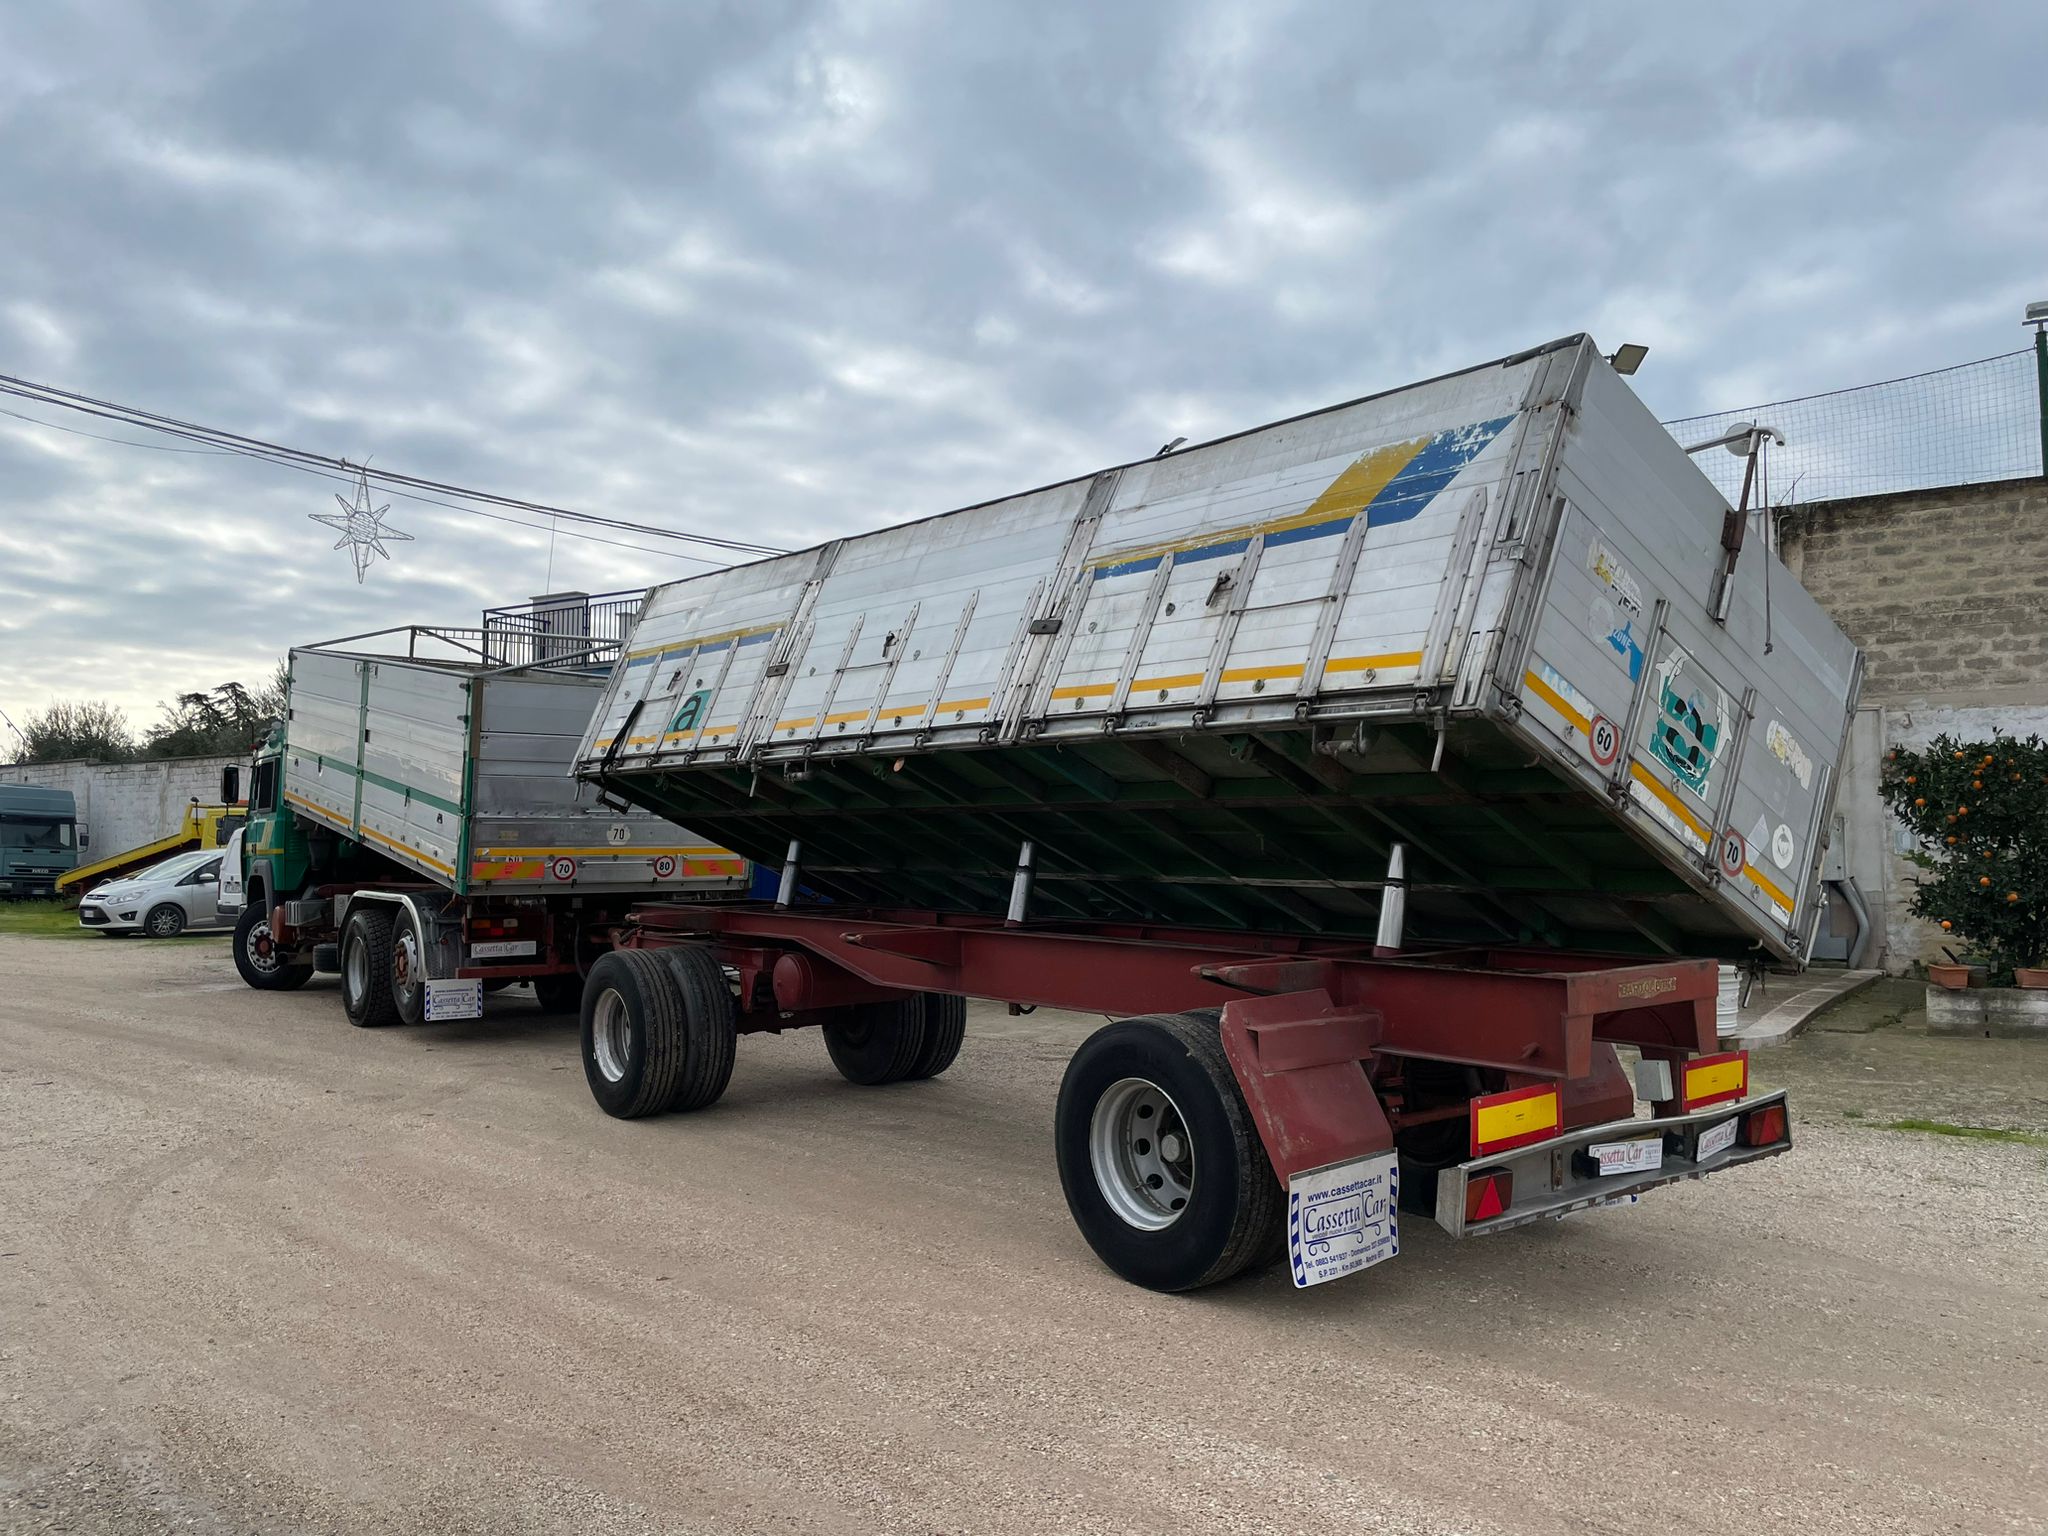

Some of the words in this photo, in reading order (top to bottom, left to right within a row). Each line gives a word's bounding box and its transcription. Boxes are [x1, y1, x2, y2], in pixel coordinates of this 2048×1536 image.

[1597, 727, 1612, 751] 60
[613, 829, 625, 840] 70
[1727, 842, 1739, 864] 70
[559, 864, 570, 874] 70
[659, 862, 670, 871] 80
[474, 944, 503, 953] Cassetta
[505, 942, 519, 953] Car
[1626, 1143, 1643, 1162] Car
[1307, 1174, 1382, 1203] www.cassettacar.it
[1305, 1206, 1361, 1233] Cassetta
[1364, 1194, 1386, 1218] Car
[1304, 1261, 1313, 1269] Tel.
[1319, 1269, 1328, 1278] S.P.
